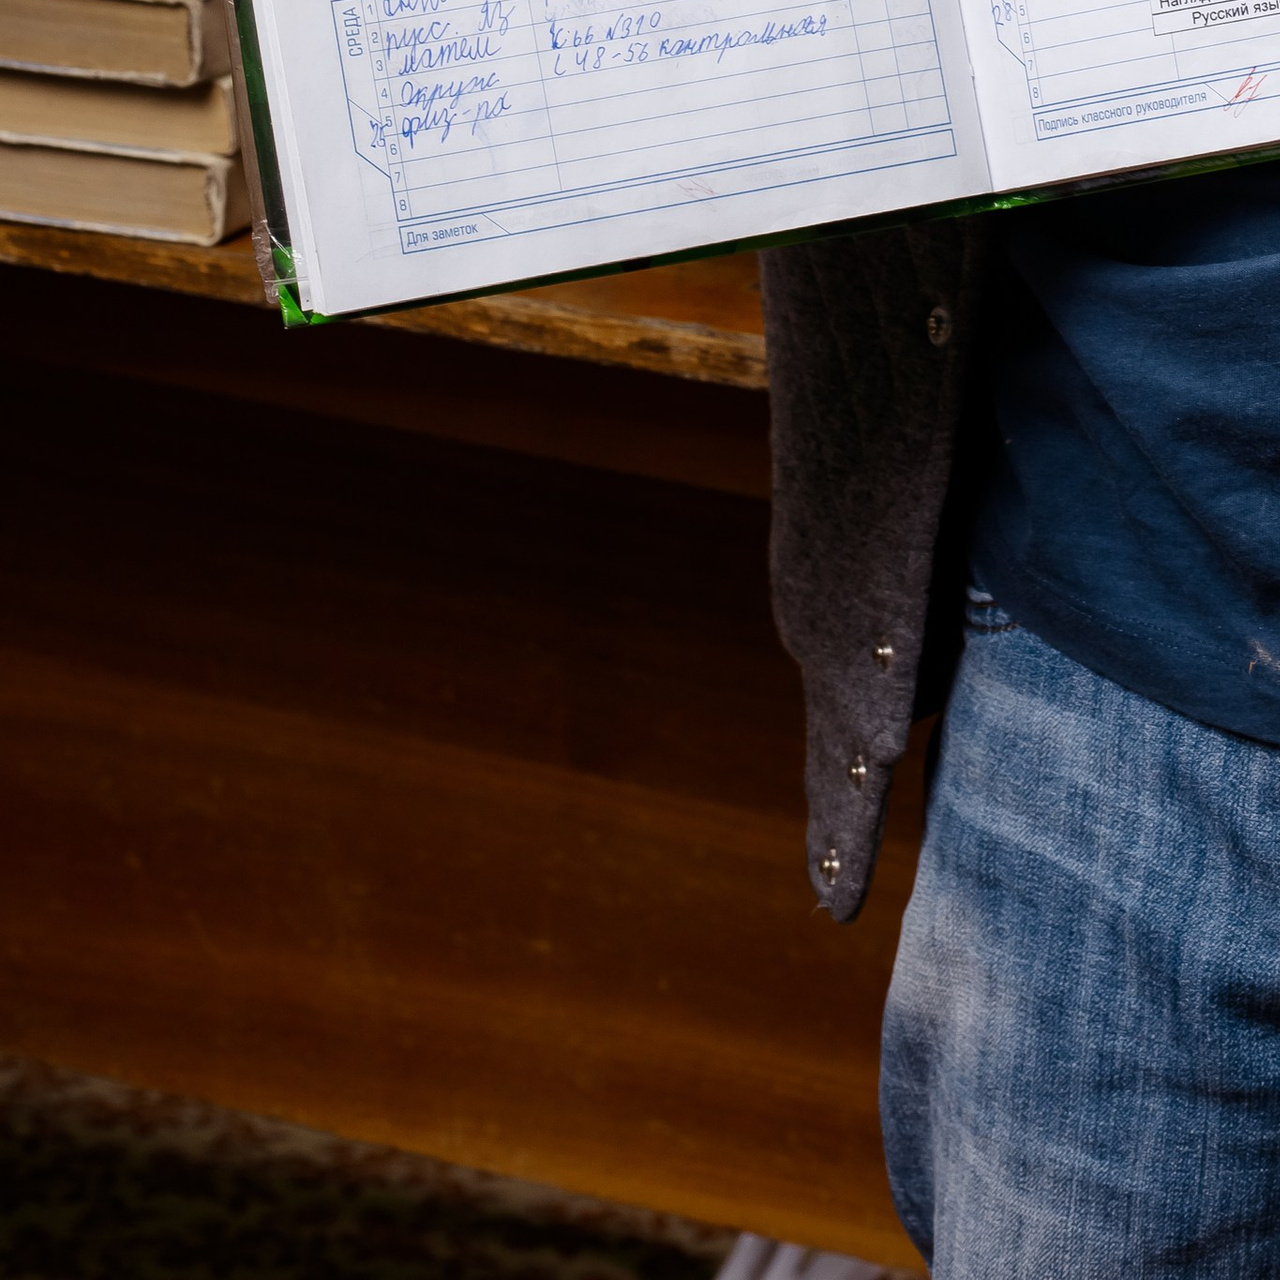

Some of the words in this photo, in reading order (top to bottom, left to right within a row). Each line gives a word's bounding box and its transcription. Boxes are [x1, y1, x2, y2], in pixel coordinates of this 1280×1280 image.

[343, 7, 363, 56] СРЕДА
[1192, 2, 1249, 27] Русский
[1038, 114, 1079, 133] Подпись
[1081, 101, 1133, 124] классного
[1135, 90, 1207, 116] руководителя
[407, 231, 429, 247] Для
[432, 223, 478, 242] заметок
